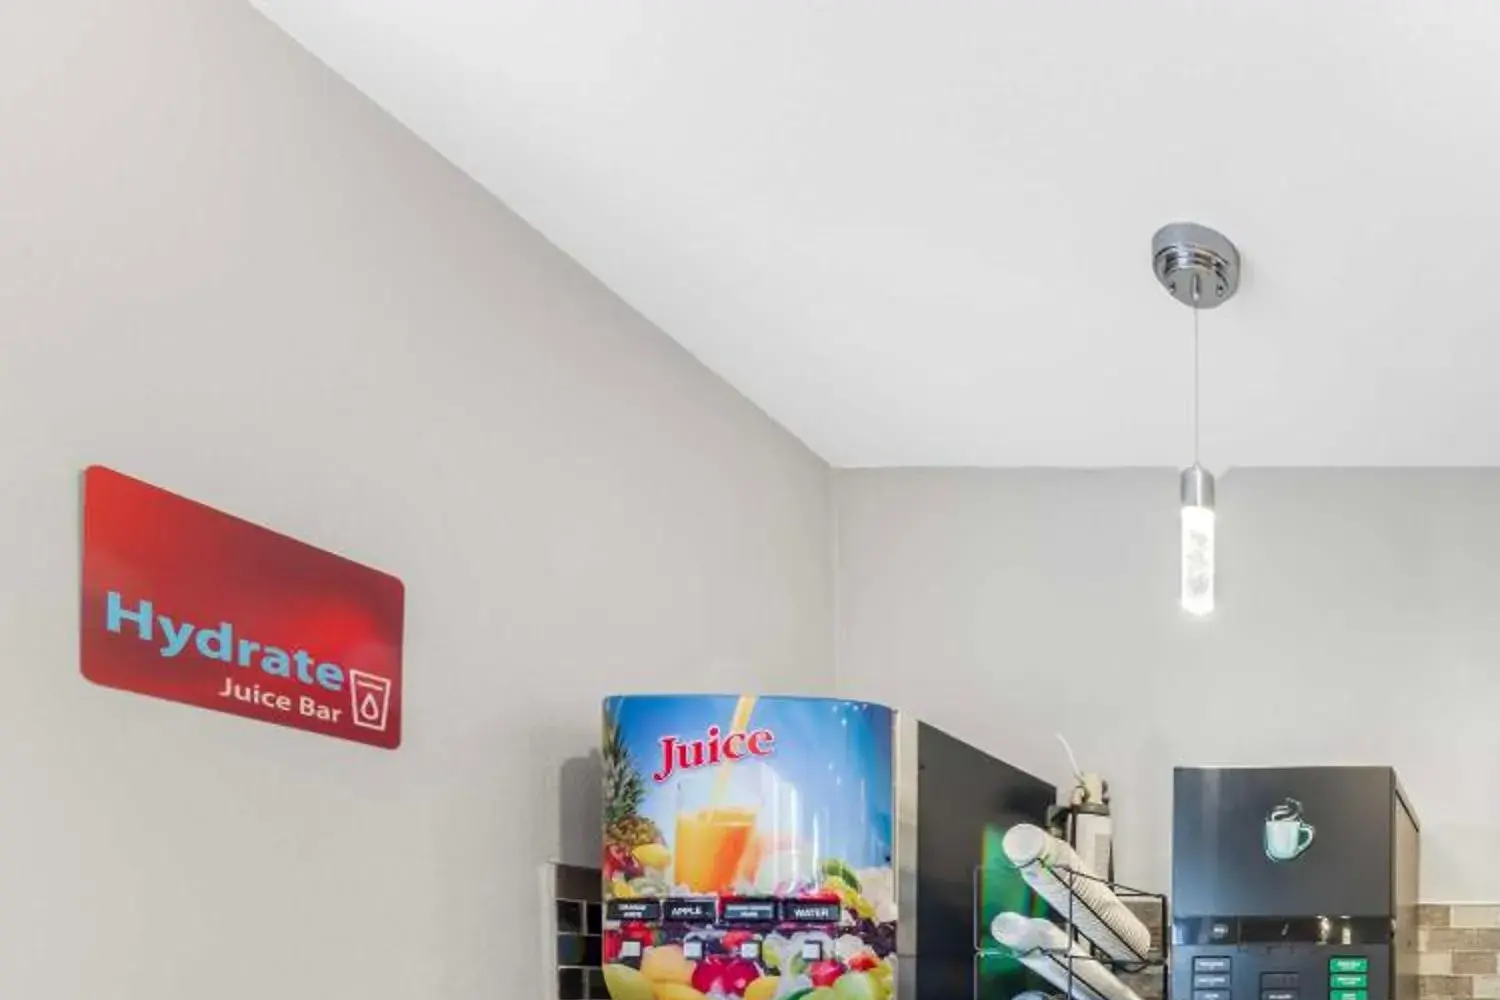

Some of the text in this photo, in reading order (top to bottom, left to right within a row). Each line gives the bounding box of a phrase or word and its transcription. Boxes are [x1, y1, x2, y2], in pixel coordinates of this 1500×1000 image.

[105, 590, 345, 691] Hydrate
[218, 677, 342, 723] Juice Bar
[651, 723, 774, 783] Juice
[671, 906, 703, 916] APPLE
[795, 908, 829, 918] WATER
